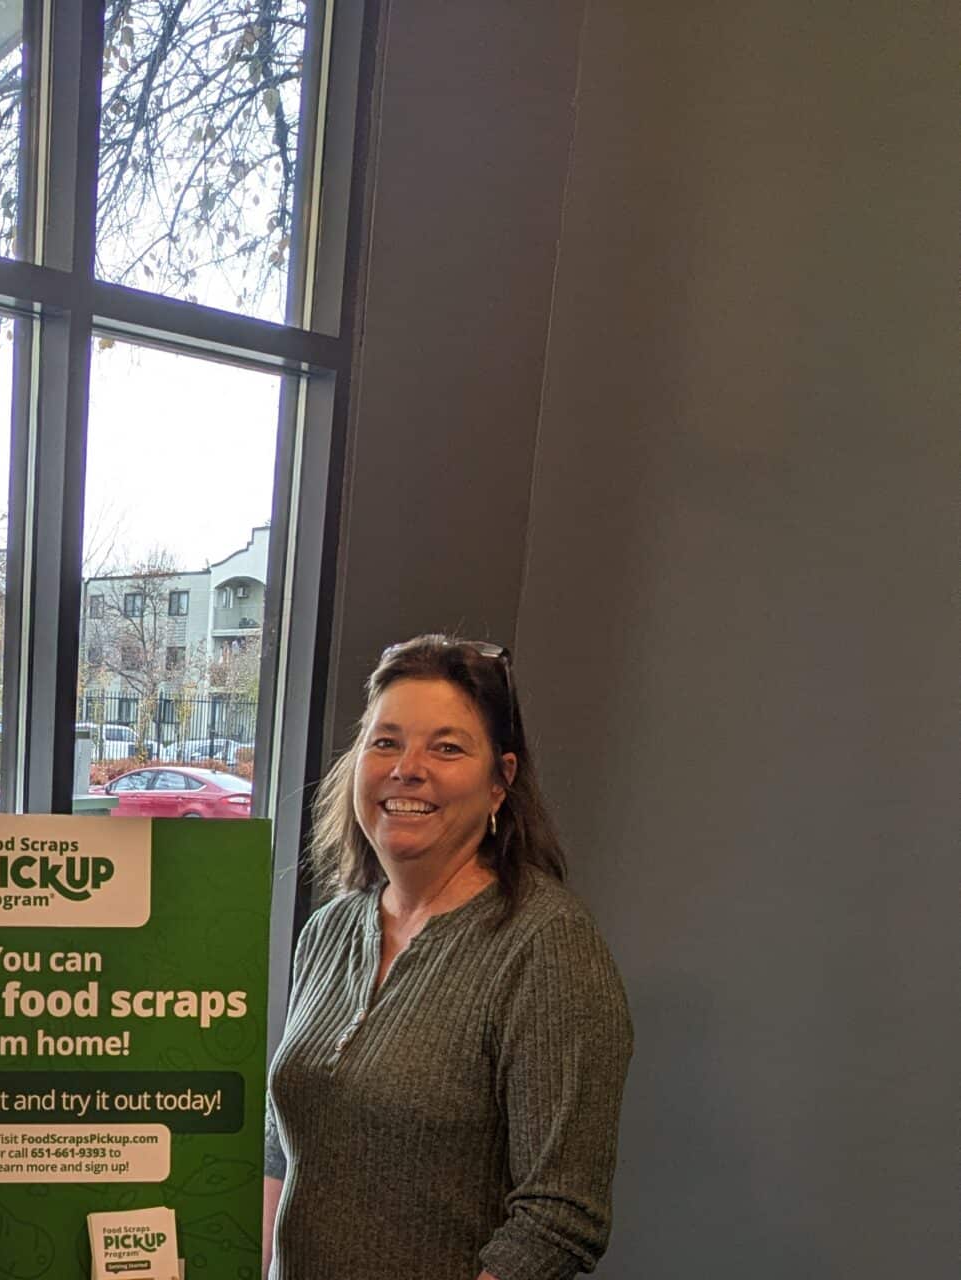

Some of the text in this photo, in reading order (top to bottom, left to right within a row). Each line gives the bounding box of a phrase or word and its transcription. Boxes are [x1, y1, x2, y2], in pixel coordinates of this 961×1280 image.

[20, 837, 79, 855] Scraps
[49, 951, 102, 972] can
[2, 981, 99, 1018] food
[111, 988, 248, 1028] scraps
[37, 1030, 130, 1056] home!
[14, 1089, 55, 1111] and
[61, 1091, 91, 1117] try
[96, 1089, 109, 1110] it
[114, 1092, 151, 1111] out
[155, 1088, 221, 1116] today!
[21, 1133, 158, 1147] FoodScrapsPickup.com
[8, 1148, 29, 1158] call
[31, 1148, 107, 1158] 651-661-9393
[109, 1149, 121, 1158] to
[26, 1163, 58, 1172] more
[60, 1161, 82, 1172] and
[85, 1162, 109, 1174] sign
[111, 1161, 129, 1174] up!
